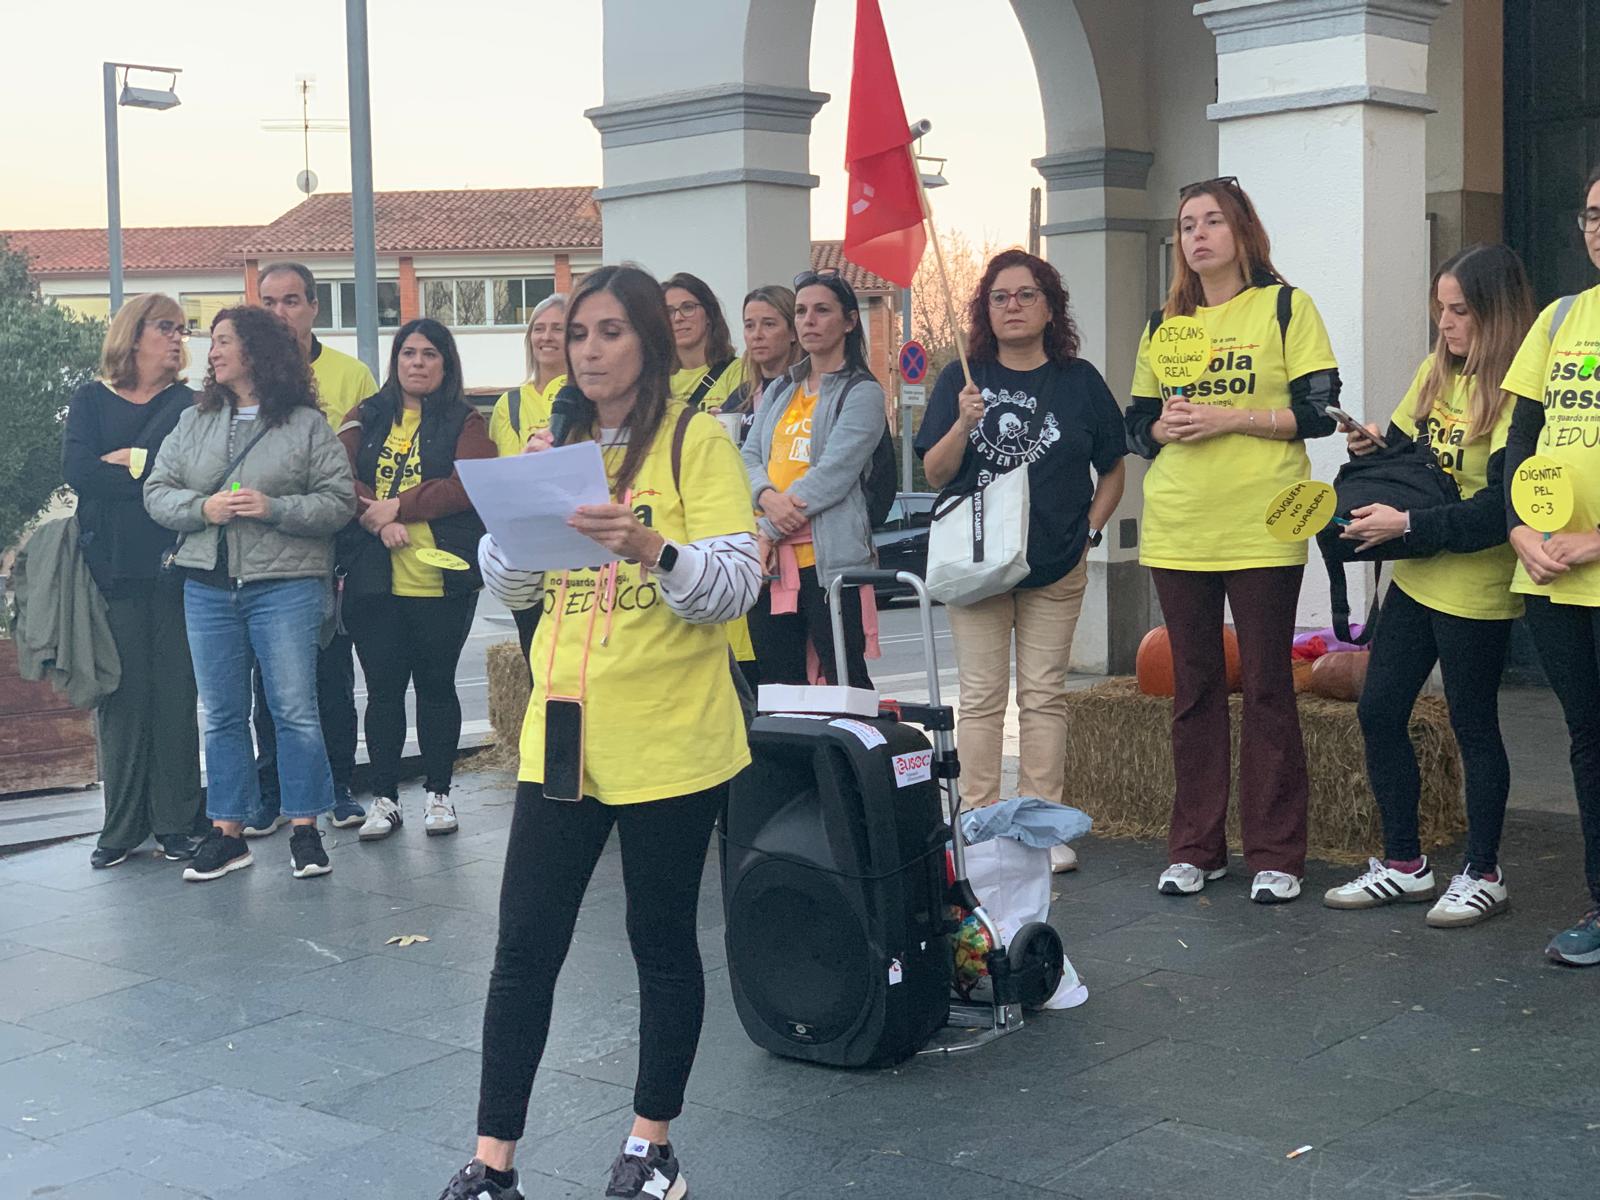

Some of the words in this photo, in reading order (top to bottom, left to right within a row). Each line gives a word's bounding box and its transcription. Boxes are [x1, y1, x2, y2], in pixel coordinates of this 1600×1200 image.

[1159, 326, 1204, 342] DESCANS
[1165, 366, 1192, 378] REAL
[996, 455, 1011, 466] EN
[1534, 486, 1554, 496] PEL
[1266, 483, 1306, 526] EDUQUEM
[1290, 503, 1303, 518] NO
[1292, 489, 1329, 535] GUARDEM
